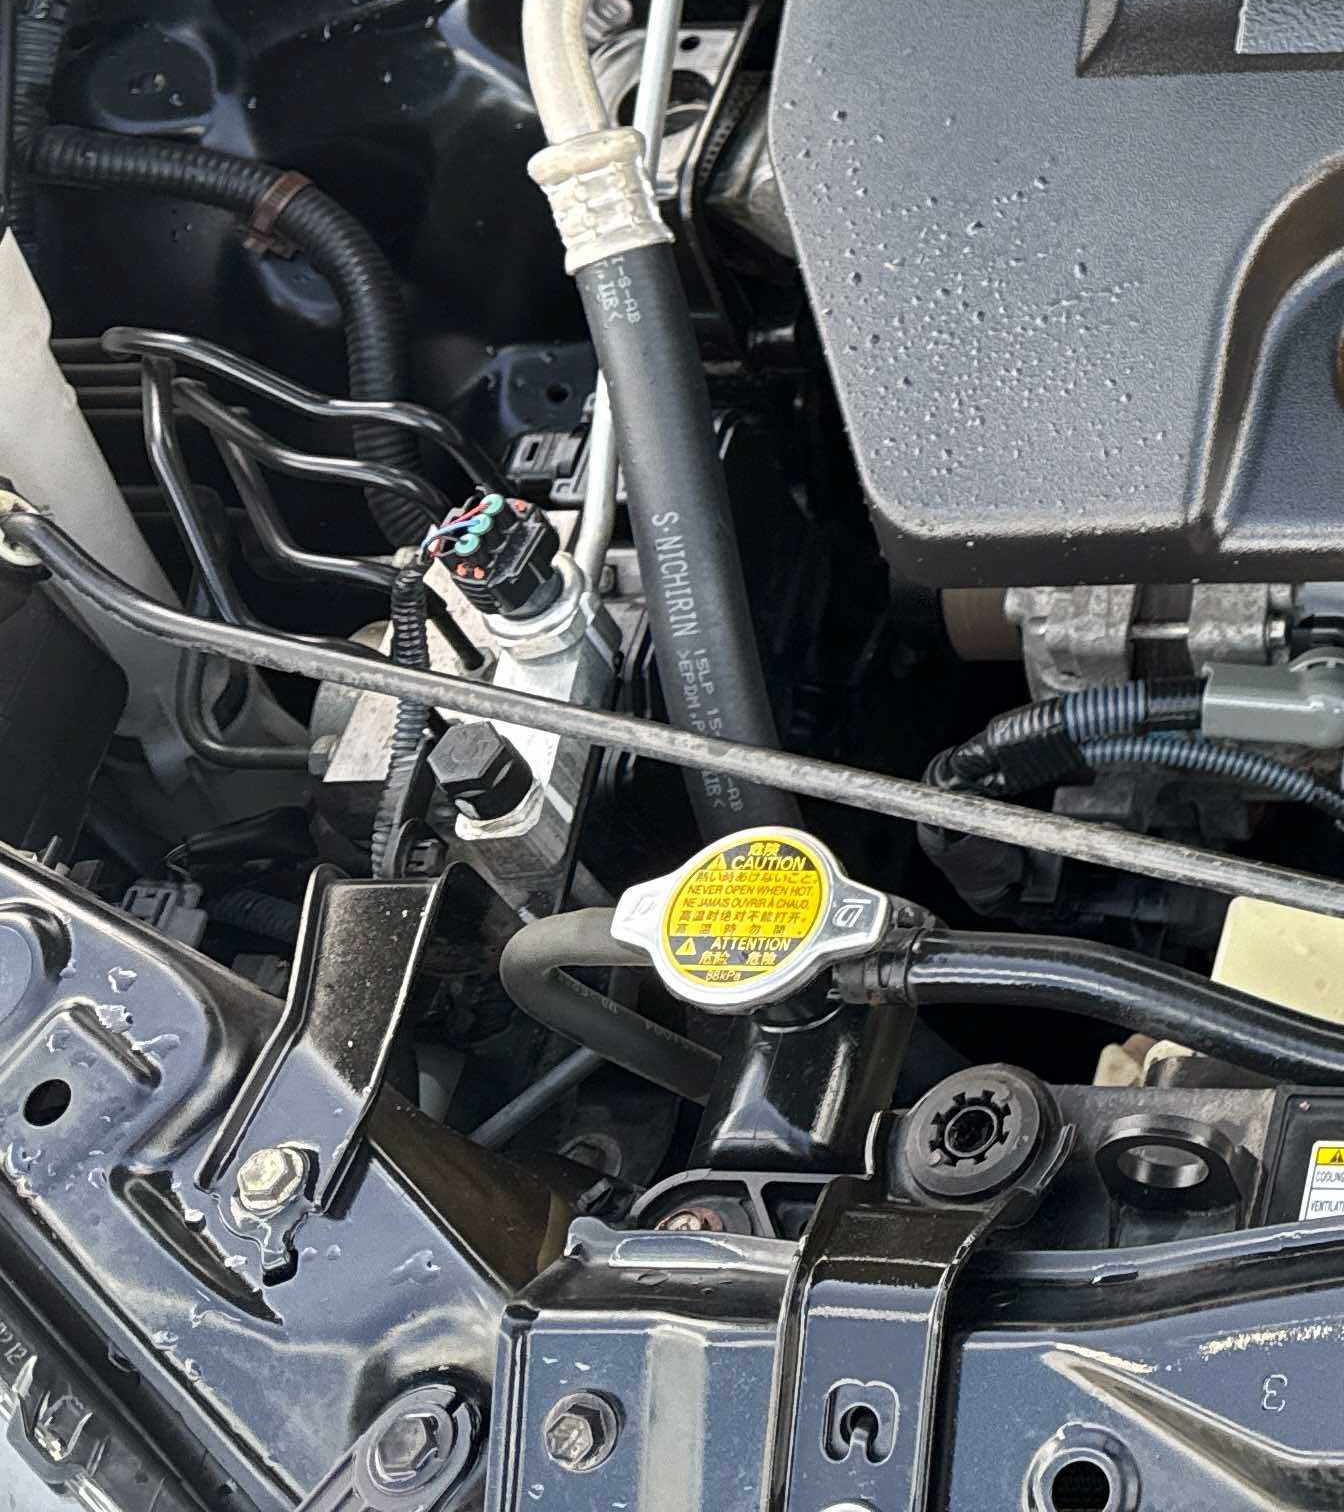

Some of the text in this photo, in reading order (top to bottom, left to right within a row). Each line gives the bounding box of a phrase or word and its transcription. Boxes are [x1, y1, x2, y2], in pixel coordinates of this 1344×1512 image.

[731, 856, 807, 871] CAUTION
[687, 885, 723, 896] NEVER
[724, 885, 755, 896] OPEN
[756, 885, 789, 896] WHEN
[682, 897, 696, 908] NE
[696, 897, 731, 908] JAMAIS
[731, 897, 766, 909] OUVRIR
[710, 936, 792, 951] ATTENTION
